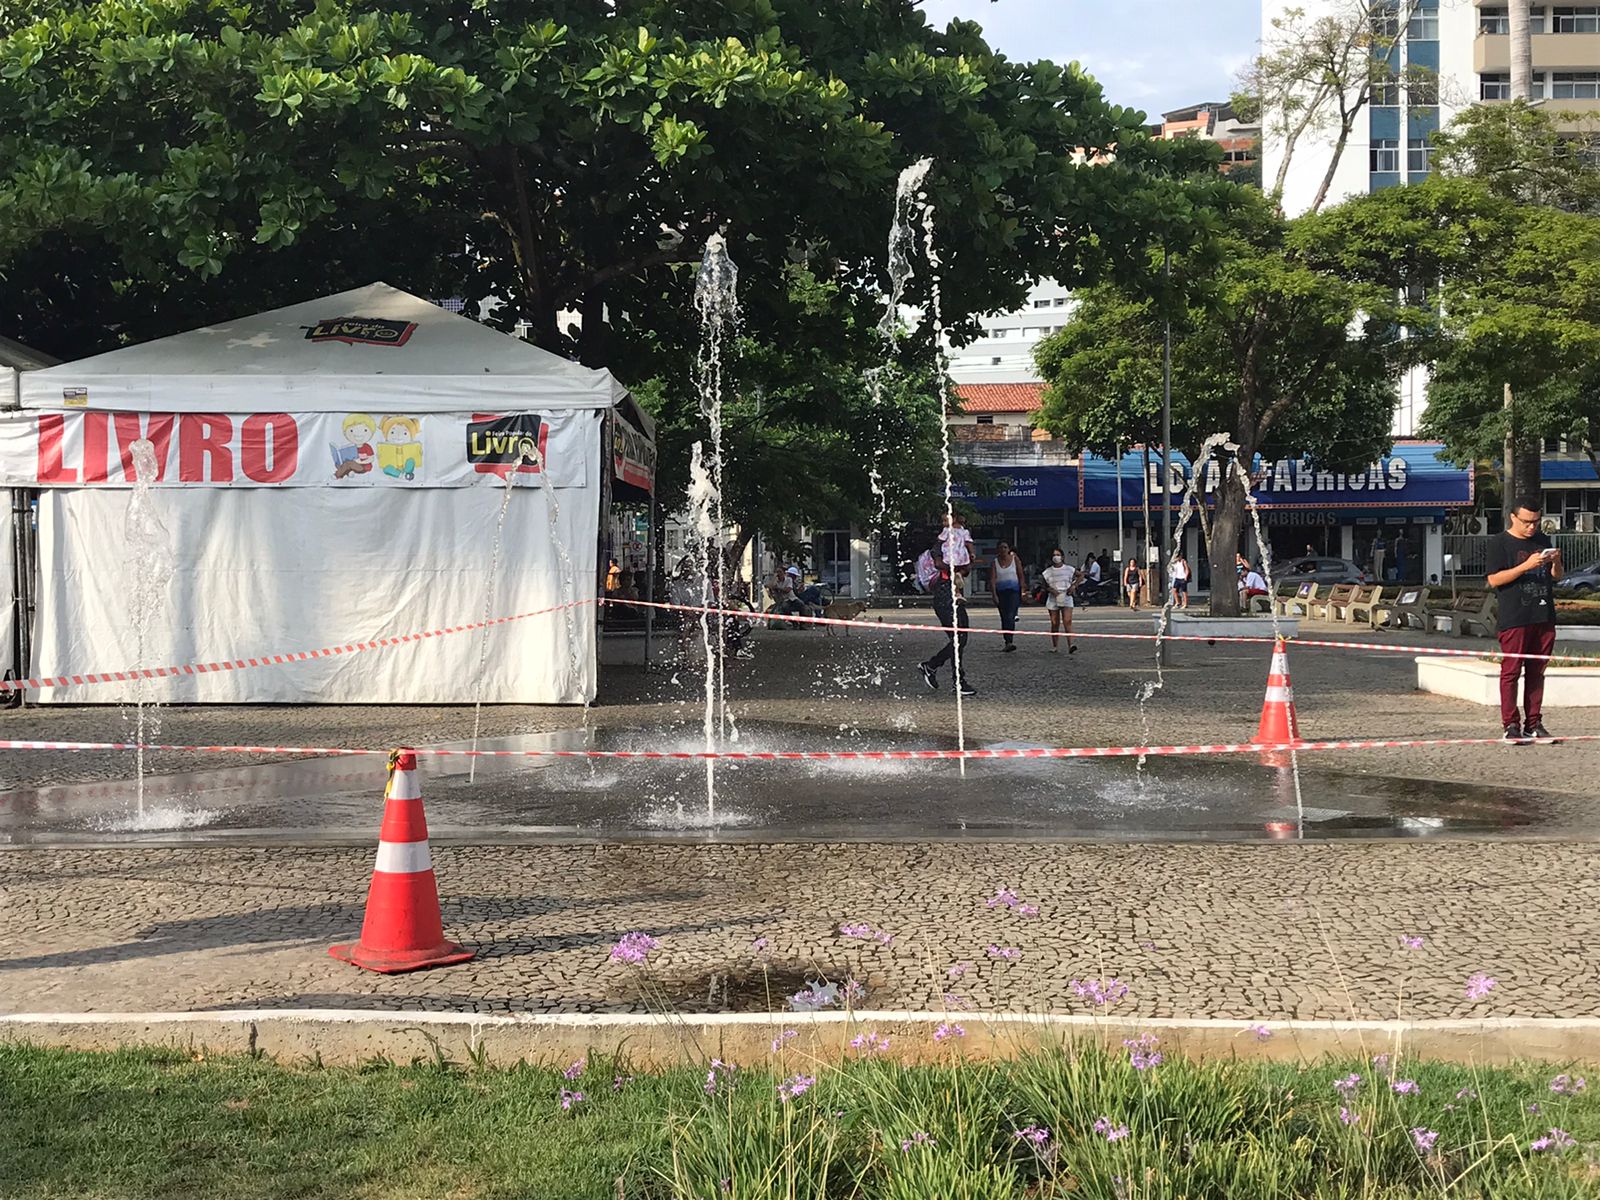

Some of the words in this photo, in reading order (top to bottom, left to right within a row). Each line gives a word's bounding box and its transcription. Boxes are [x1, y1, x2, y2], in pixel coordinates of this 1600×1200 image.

[37, 412, 299, 483] LIVRO
[472, 431, 535, 456] Livro
[1008, 488, 1037, 497] infantil
